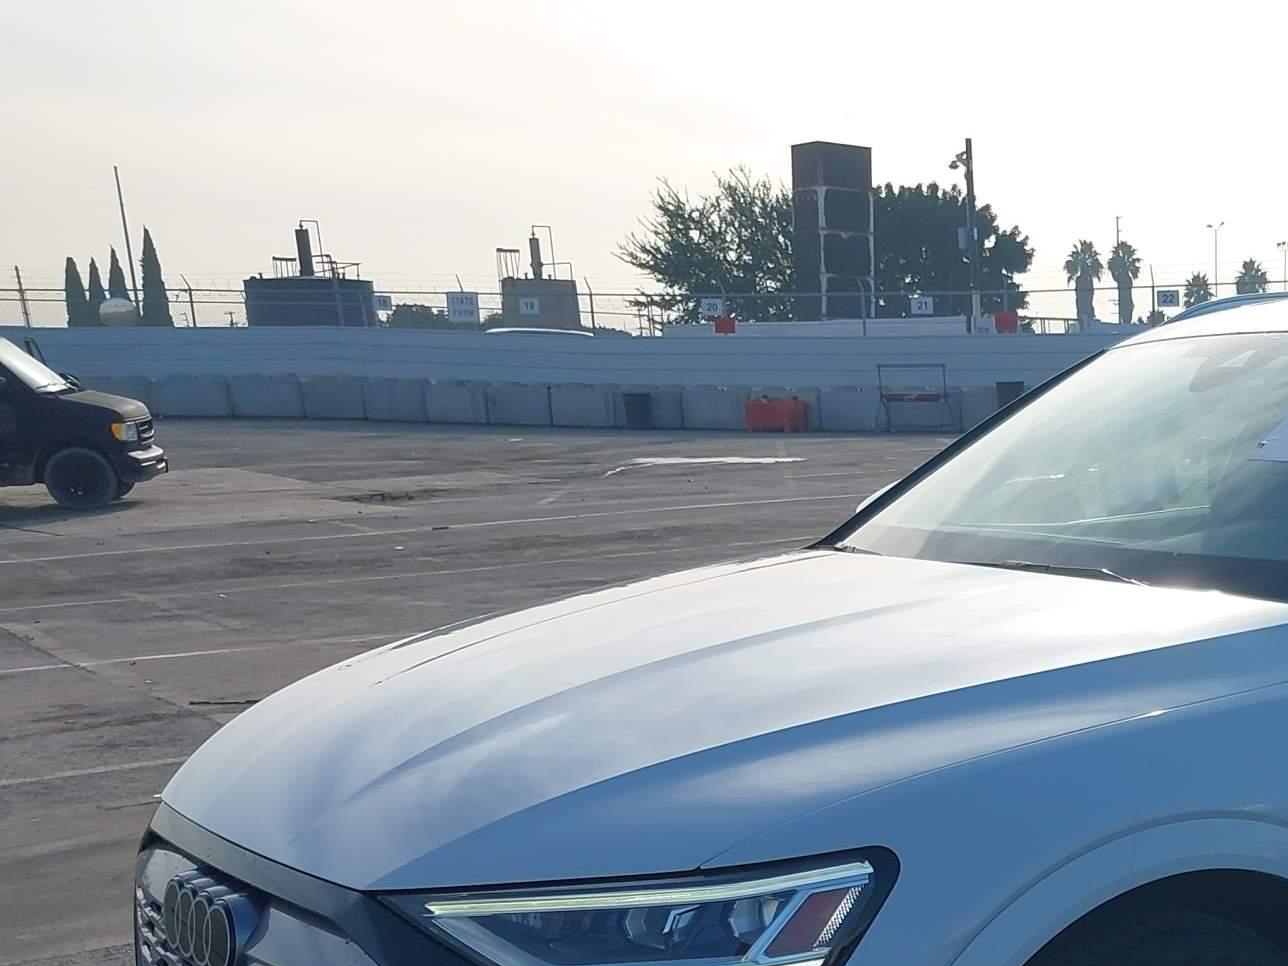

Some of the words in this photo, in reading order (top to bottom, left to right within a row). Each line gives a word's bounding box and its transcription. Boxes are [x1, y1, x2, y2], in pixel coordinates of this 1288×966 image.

[1162, 294, 1175, 304] 22
[707, 302, 719, 312] 20
[918, 301, 928, 310] 21
